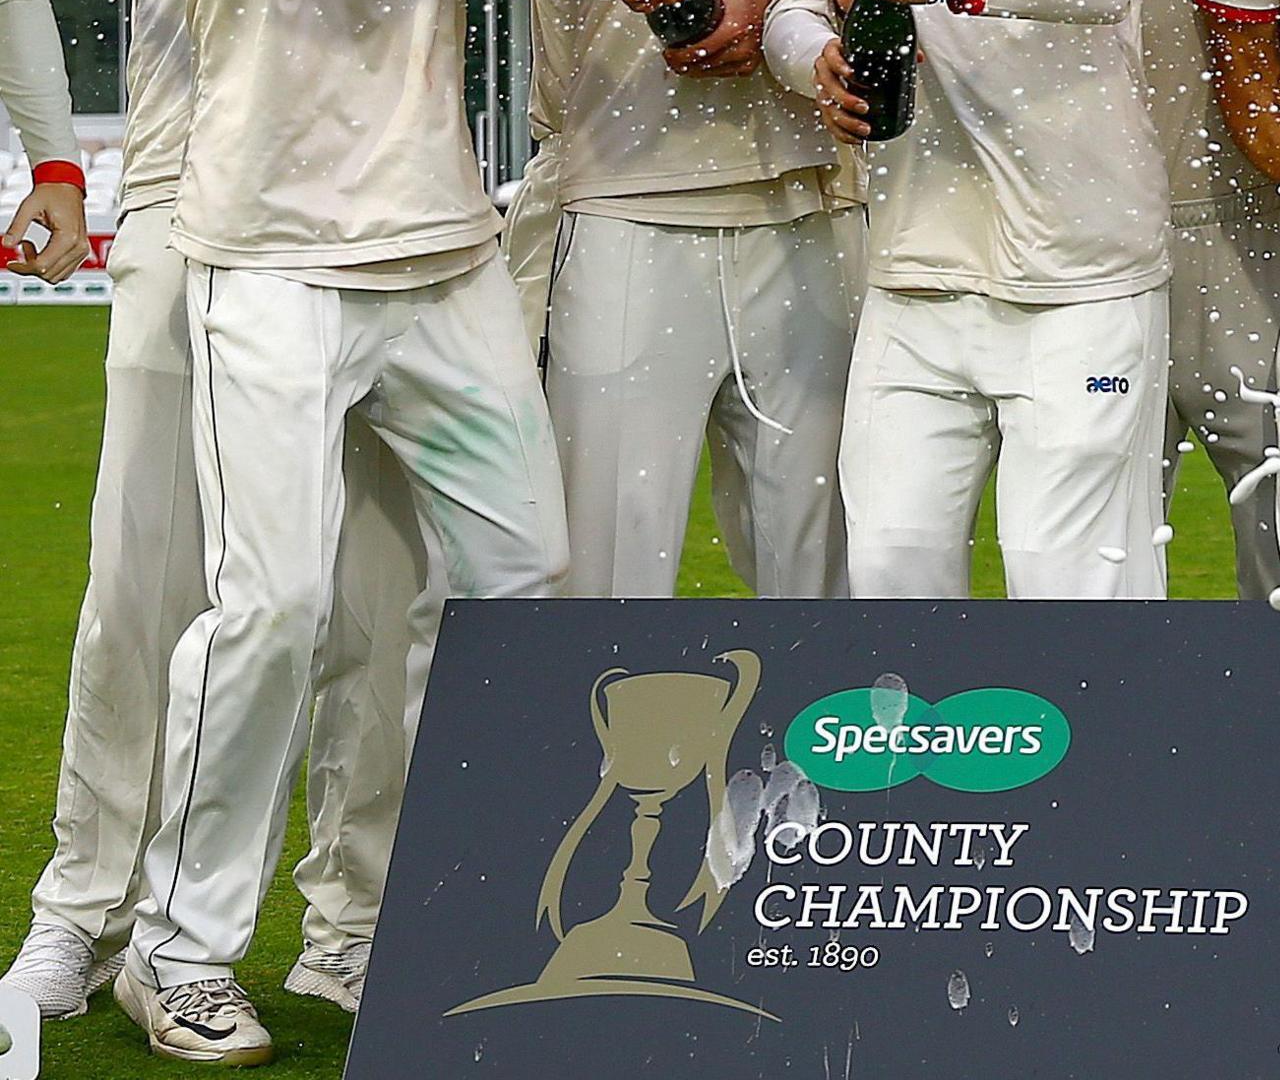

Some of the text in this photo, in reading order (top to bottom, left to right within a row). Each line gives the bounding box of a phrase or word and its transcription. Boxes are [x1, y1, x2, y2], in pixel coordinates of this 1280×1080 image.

[1086, 376, 1129, 394] aero
[811, 717, 1042, 762] Specsavers
[765, 823, 1029, 866] COUNTY
[754, 883, 1248, 934] CHAMPIONSHIP
[747, 944, 879, 971] est. 1890
